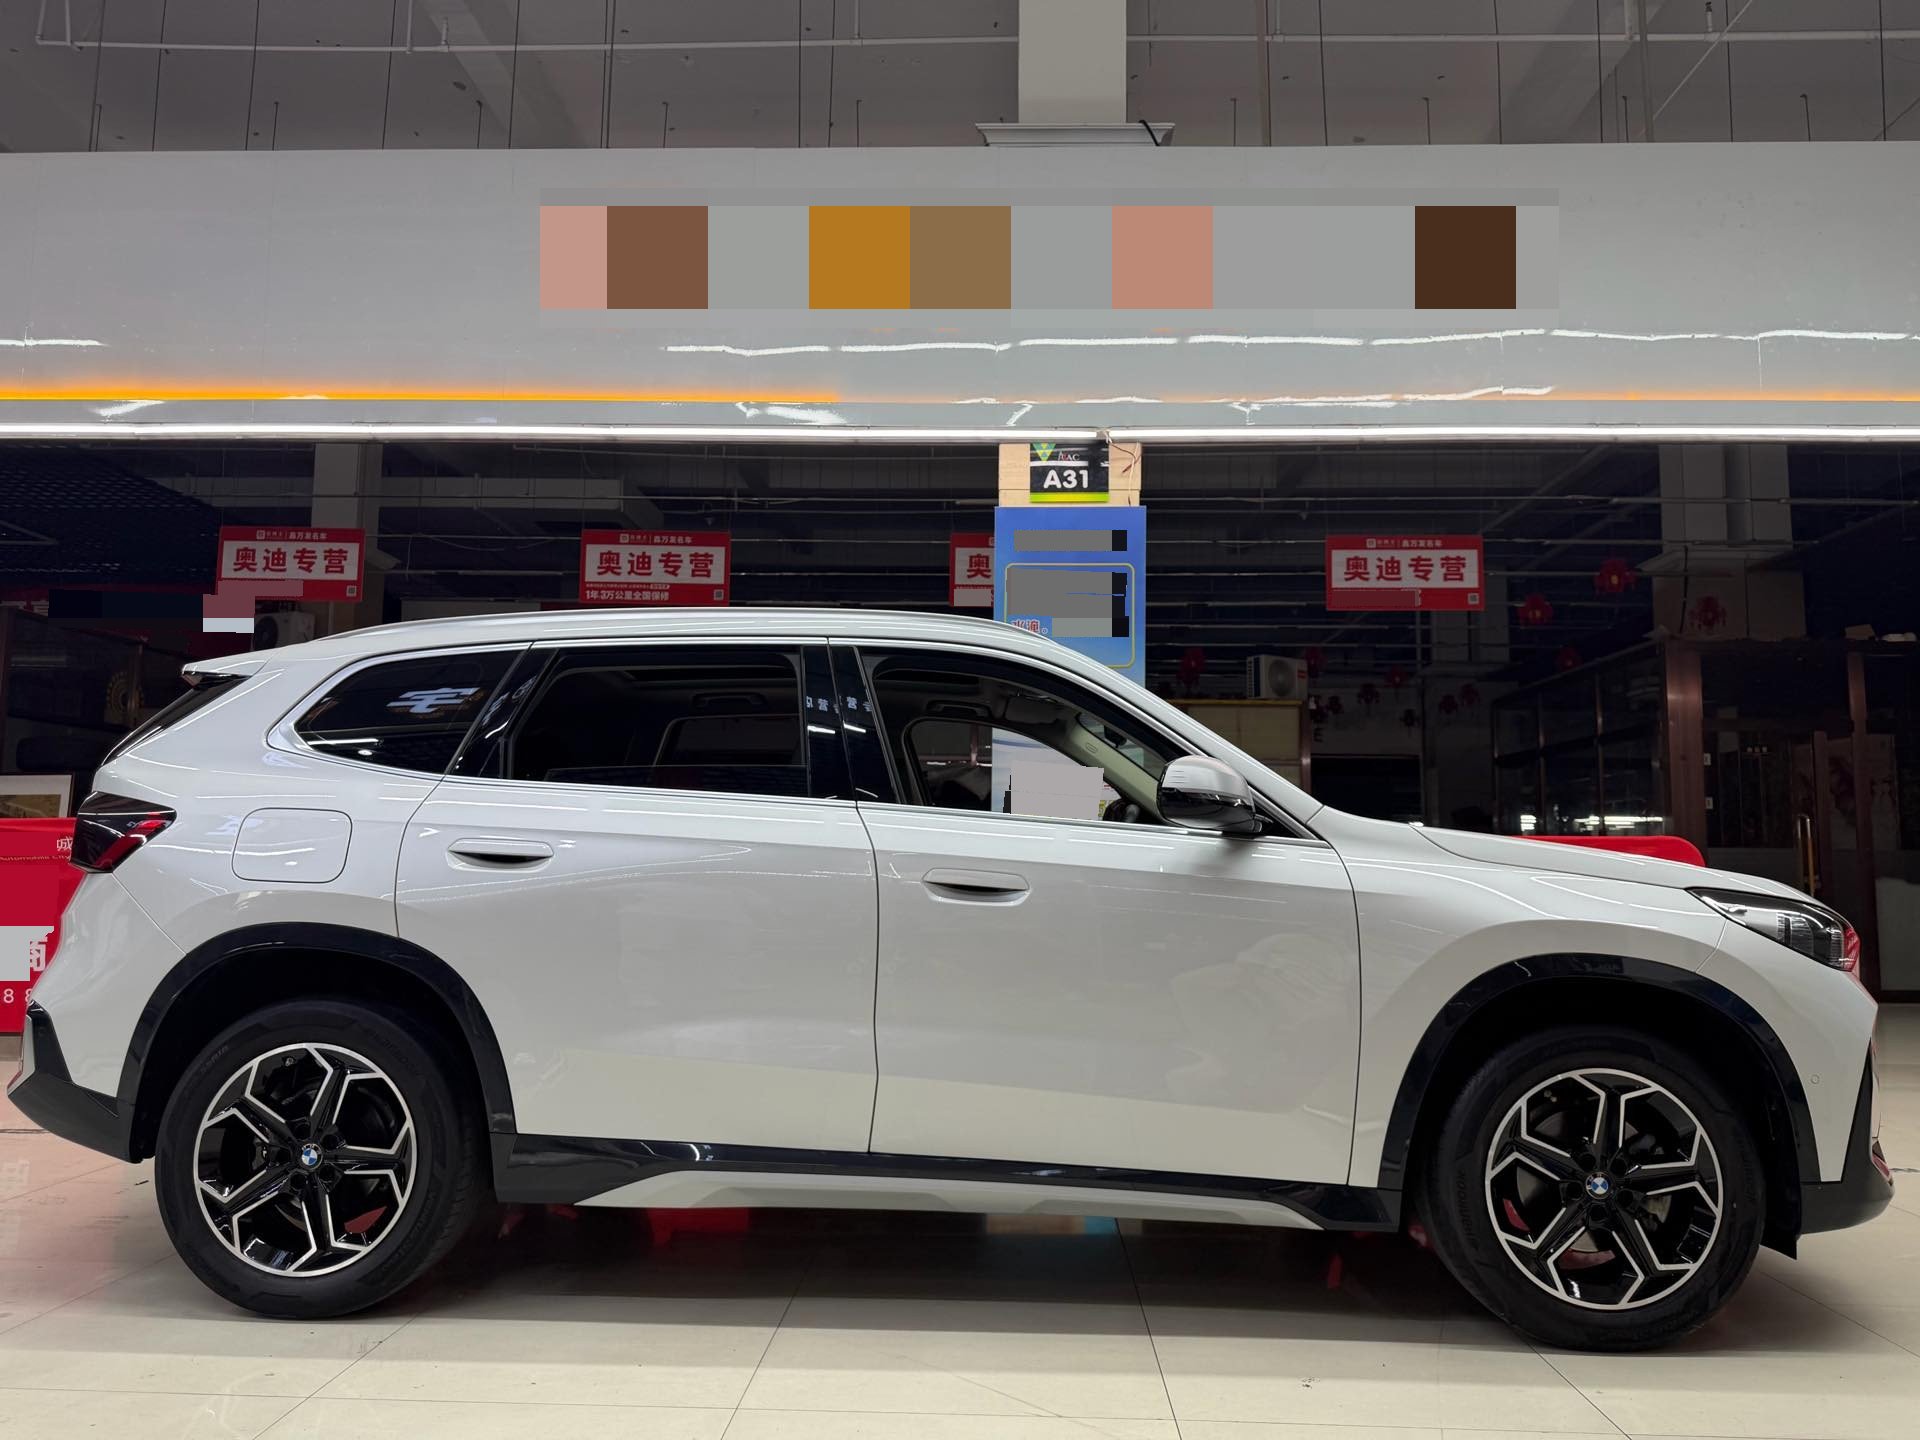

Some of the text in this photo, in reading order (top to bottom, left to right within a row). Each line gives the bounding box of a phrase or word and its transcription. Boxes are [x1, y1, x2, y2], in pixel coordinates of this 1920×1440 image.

[1043, 469, 1088, 489] A31
[233, 546, 348, 574] 奥迪专营
[597, 550, 714, 578] 奥迪专营
[1344, 556, 1466, 582] 奥迪专营
